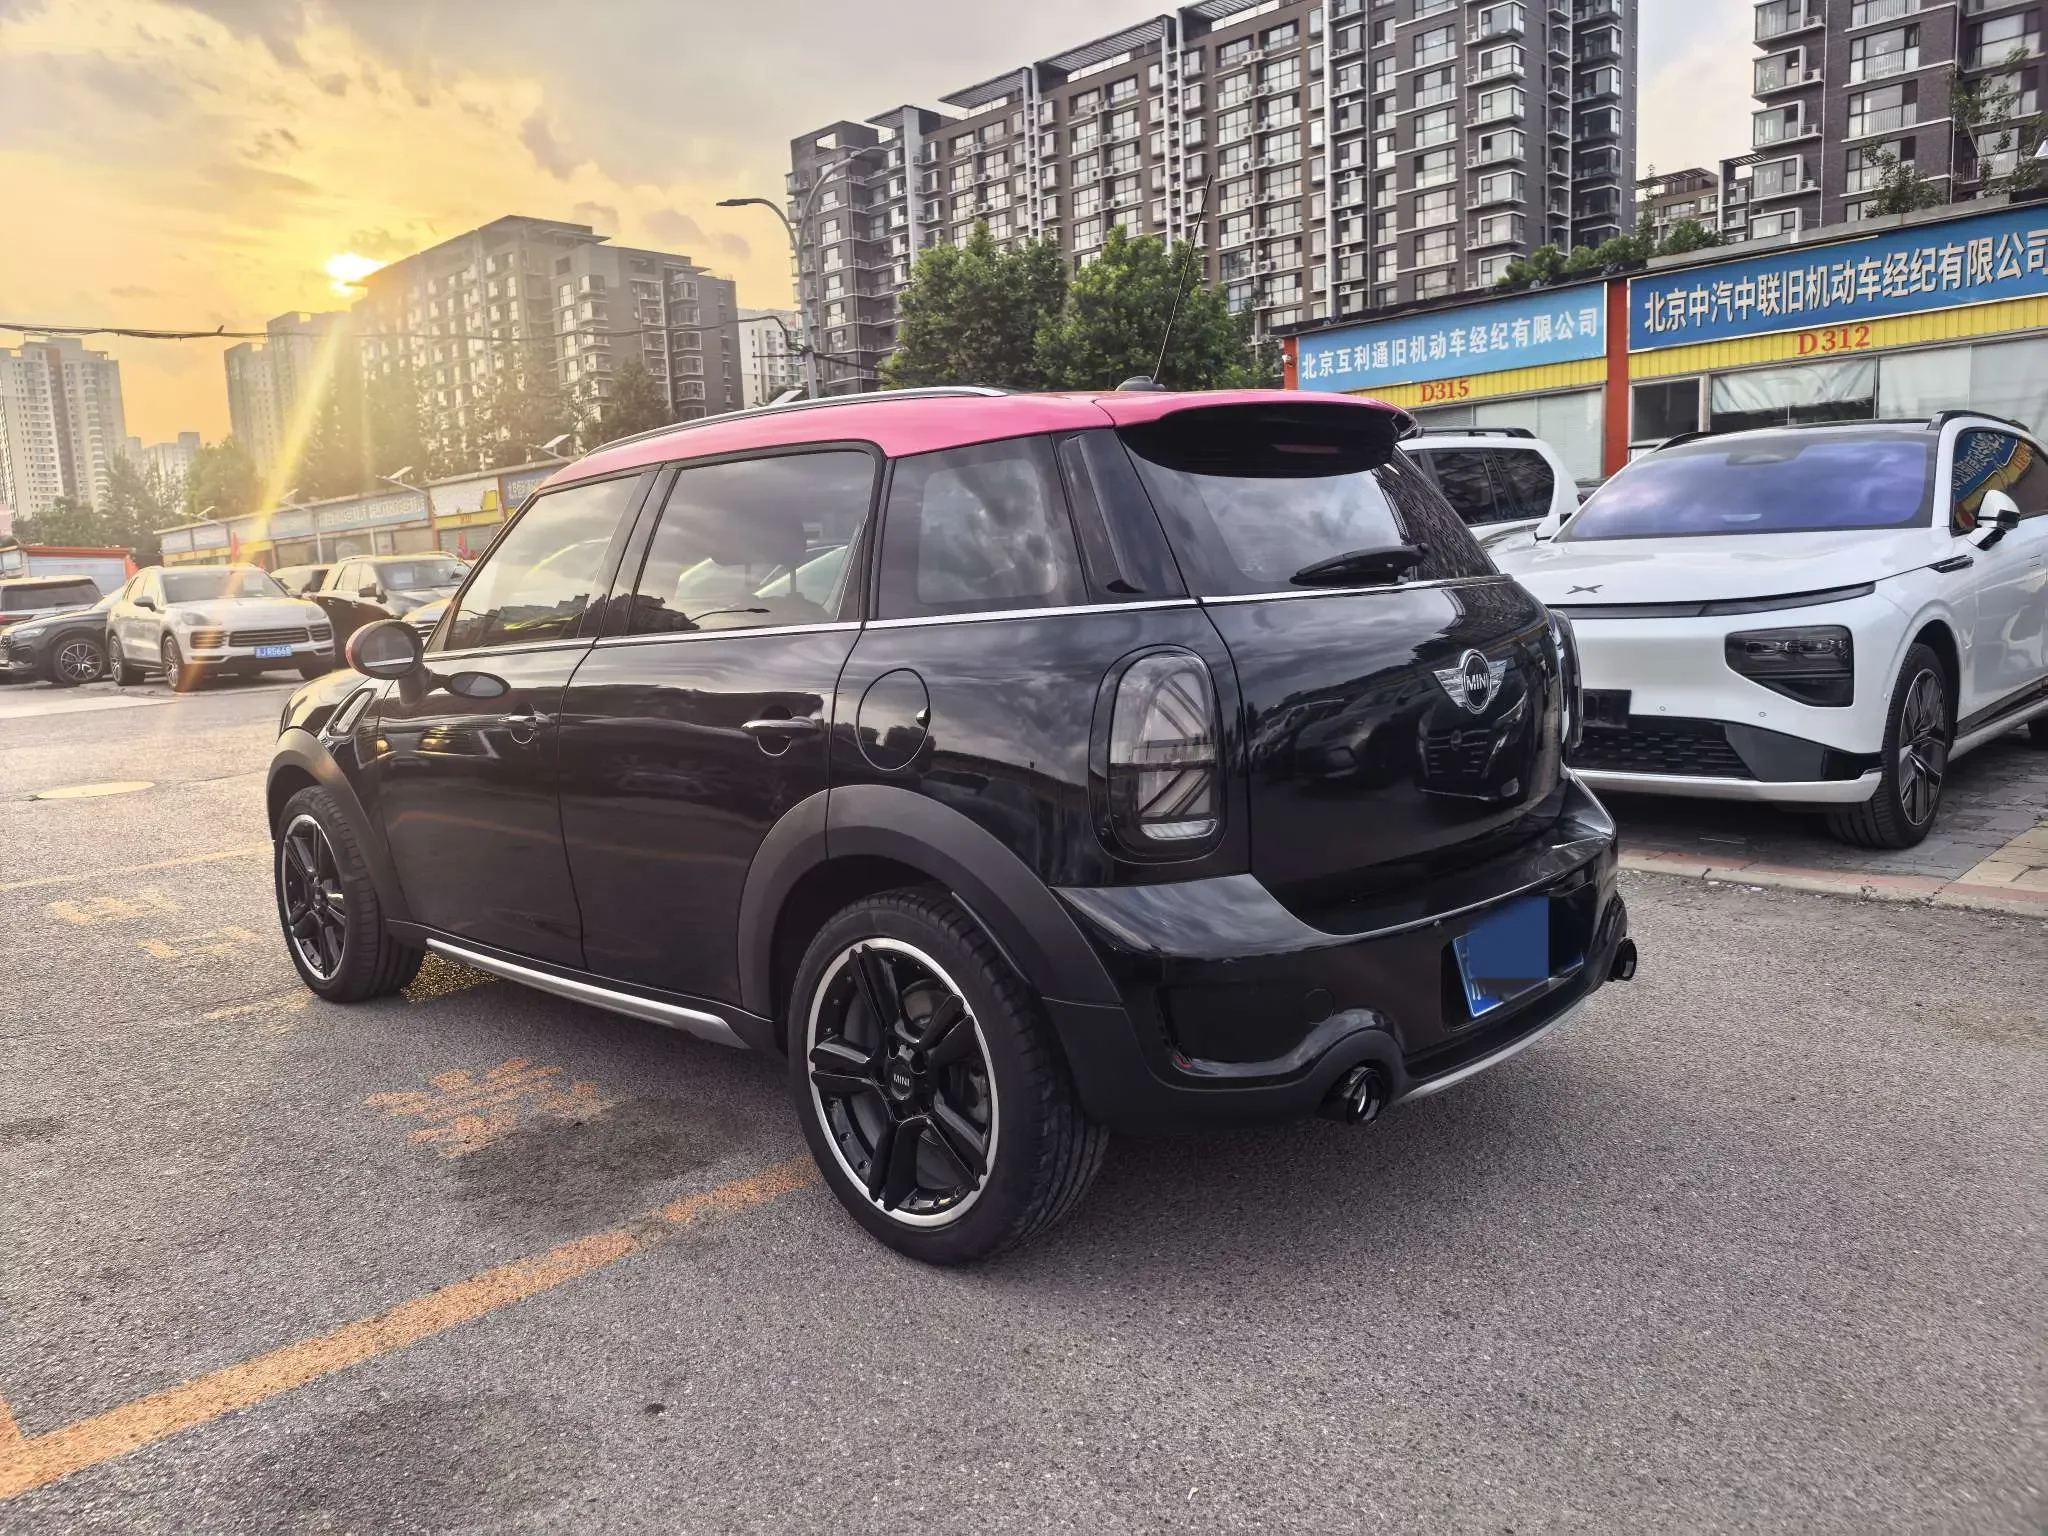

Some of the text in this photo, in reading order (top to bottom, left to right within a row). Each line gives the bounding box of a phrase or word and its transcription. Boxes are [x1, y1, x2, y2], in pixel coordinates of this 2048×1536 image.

[1643, 229, 2048, 334] 北京中汽中联旧机动车经纪有限公司
[1301, 307, 1598, 380] 北京互利通旧机动车经纪有限公司
[1797, 325, 1871, 355] D312
[1421, 379, 1470, 402] D315
[1465, 672, 1489, 691] MINI
